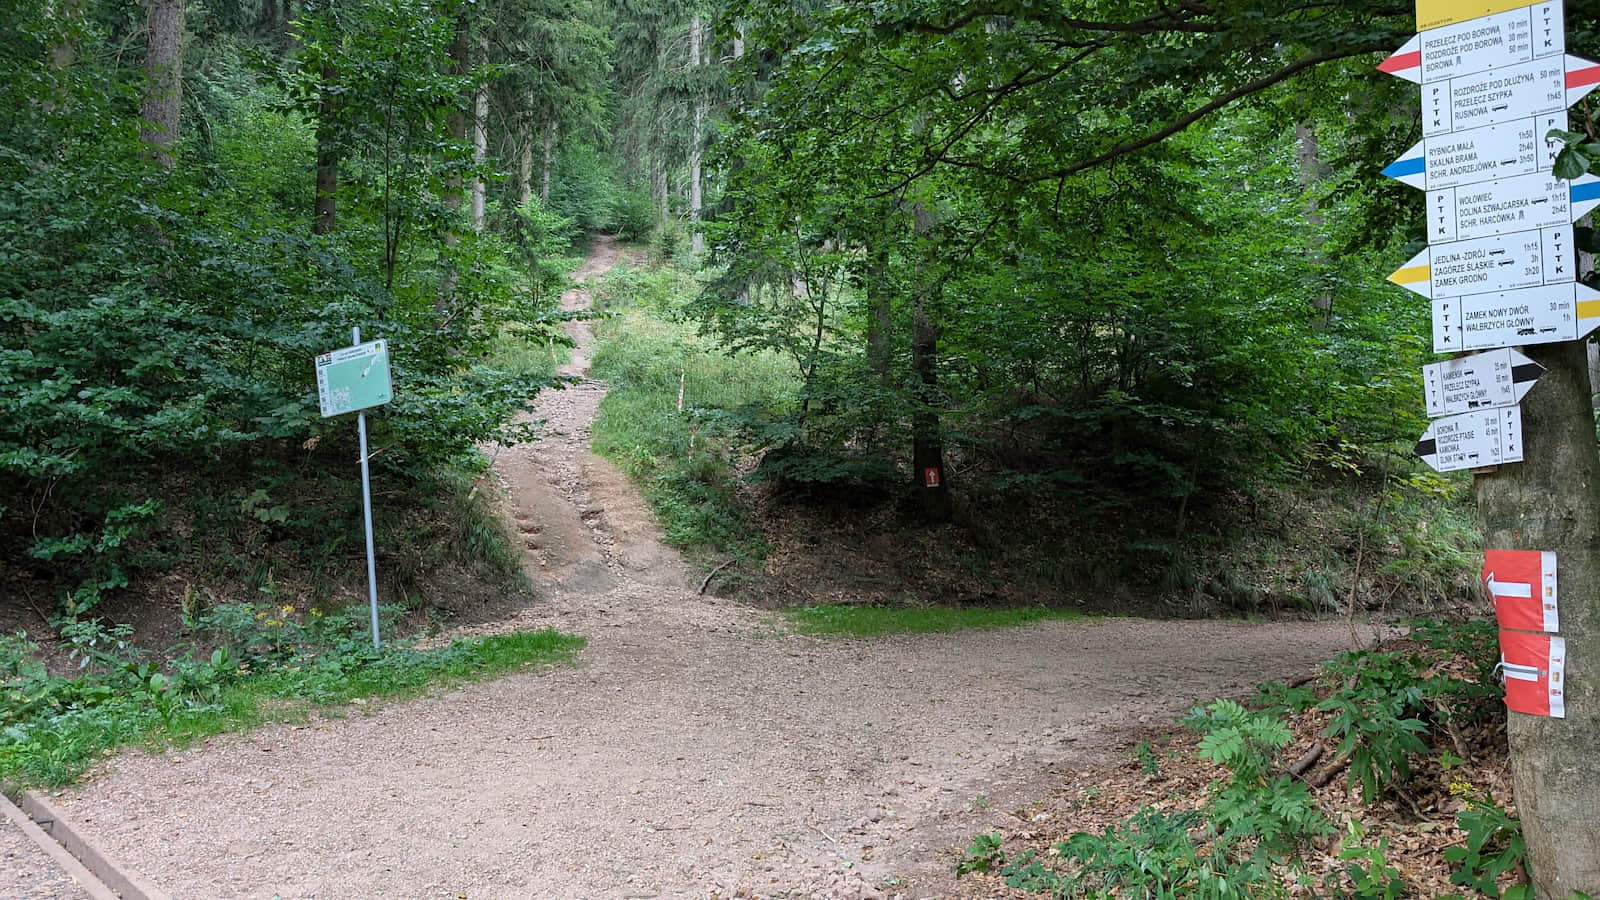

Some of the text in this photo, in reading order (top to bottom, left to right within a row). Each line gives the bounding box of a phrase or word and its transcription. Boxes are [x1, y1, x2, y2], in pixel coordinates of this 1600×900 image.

[1458, 32, 1471, 42] POD
[1508, 21, 1515, 31] 10
[1516, 19, 1528, 28] min
[1460, 43, 1473, 53] POD
[1508, 33, 1515, 42] 30
[1517, 31, 1528, 40] min
[1426, 42, 1528, 72] BOROWA 50 min
[1488, 90, 1513, 102] SZYPKA
[1553, 79, 1561, 88] 1h
[1489, 80, 1503, 90] POD
[1540, 70, 1547, 79] 50
[1549, 68, 1560, 76] min
[1455, 90, 1562, 120] RUSINOWA 1h45
[1457, 140, 1474, 151] MAŁA
[1519, 129, 1533, 140] 1h50
[1429, 141, 1533, 168] SKALNA BRAMA 2h40
[1430, 169, 1448, 180] SCHR.
[1450, 160, 1497, 177] ANDRZEJÓWKA
[1545, 182, 1552, 191] 30
[1554, 181, 1565, 190] min
[1460, 192, 1566, 217] DOLINA SZWAJCARSKA 1h15
[1460, 203, 1567, 229] SCHR. HARCÓWKA 2h45
[1434, 253, 1460, 265] JEDLINA
[1524, 241, 1538, 252] 1h15
[1434, 254, 1539, 276] ZAGÓRZE ŚLĄSKIE 3h
[1435, 265, 1540, 288] ZAMEK GRODNO 3h20
[1465, 301, 1570, 321] ZAMEK NOWY DWÓR 30 min
[1466, 313, 1571, 332] WAŁBRZYCH GŁÓWNY 1h
